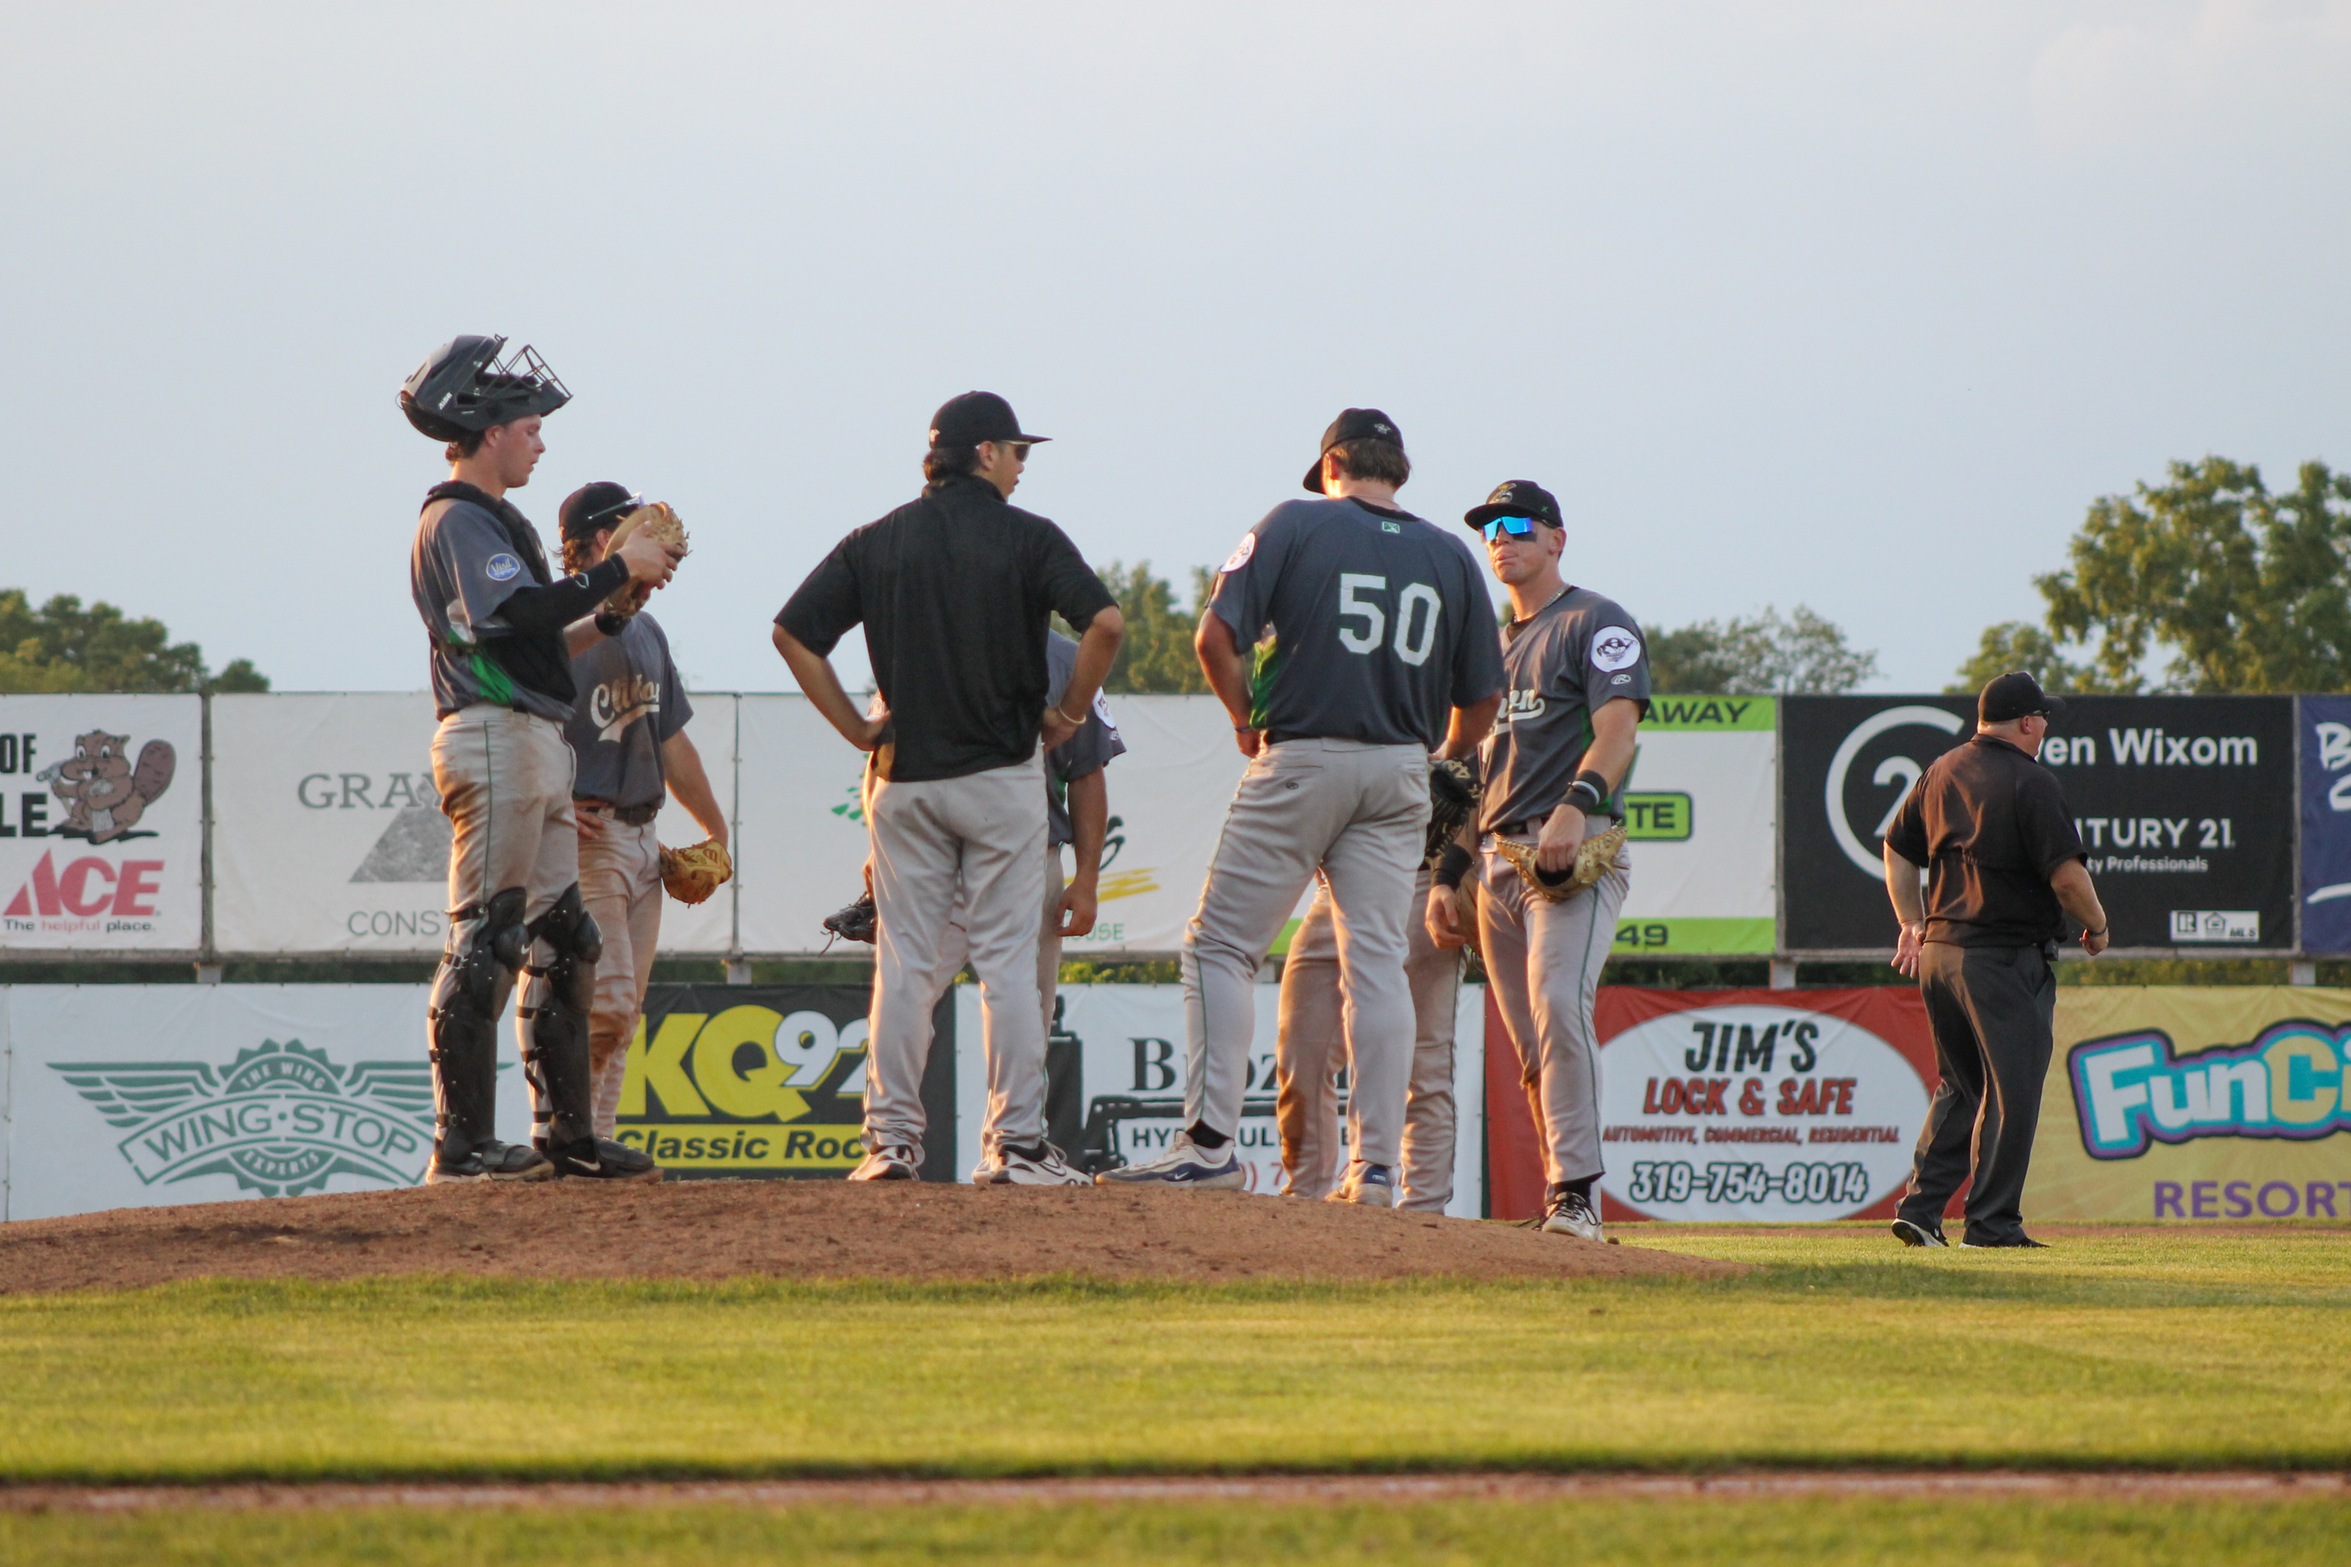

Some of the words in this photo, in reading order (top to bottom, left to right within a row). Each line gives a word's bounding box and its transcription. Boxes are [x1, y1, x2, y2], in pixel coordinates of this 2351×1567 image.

[1339, 572, 1442, 667] 50
[0, 733, 37, 774] OF
[2108, 728, 2258, 766] Wixom
[2198, 817, 2232, 849] 21
[2106, 855, 2209, 872] Professionals
[3, 848, 166, 918] ACE
[3, 918, 35, 931] The
[42, 919, 100, 933] helpful
[106, 919, 156, 933] place.
[347, 910, 442, 937] CONS
[1685, 1019, 1820, 1073] JIM'S
[239, 1063, 272, 1088] THE
[280, 1061, 327, 1090] WING
[1643, 1077, 1731, 1115] LOCK
[1738, 1077, 1766, 1116] &
[1777, 1077, 1857, 1115] SAFE
[615, 1130, 770, 1160] Classic
[784, 1130, 866, 1160] Roc
[1602, 1126, 1698, 1145] AUTOMOTIVE,
[1704, 1126, 1803, 1146] COMMERCIAL,
[1808, 1126, 1899, 1143] RESIDENTIAL
[243, 1150, 321, 1176] EXPERTS
[1629, 1161, 1869, 1203] 319-754-8014
